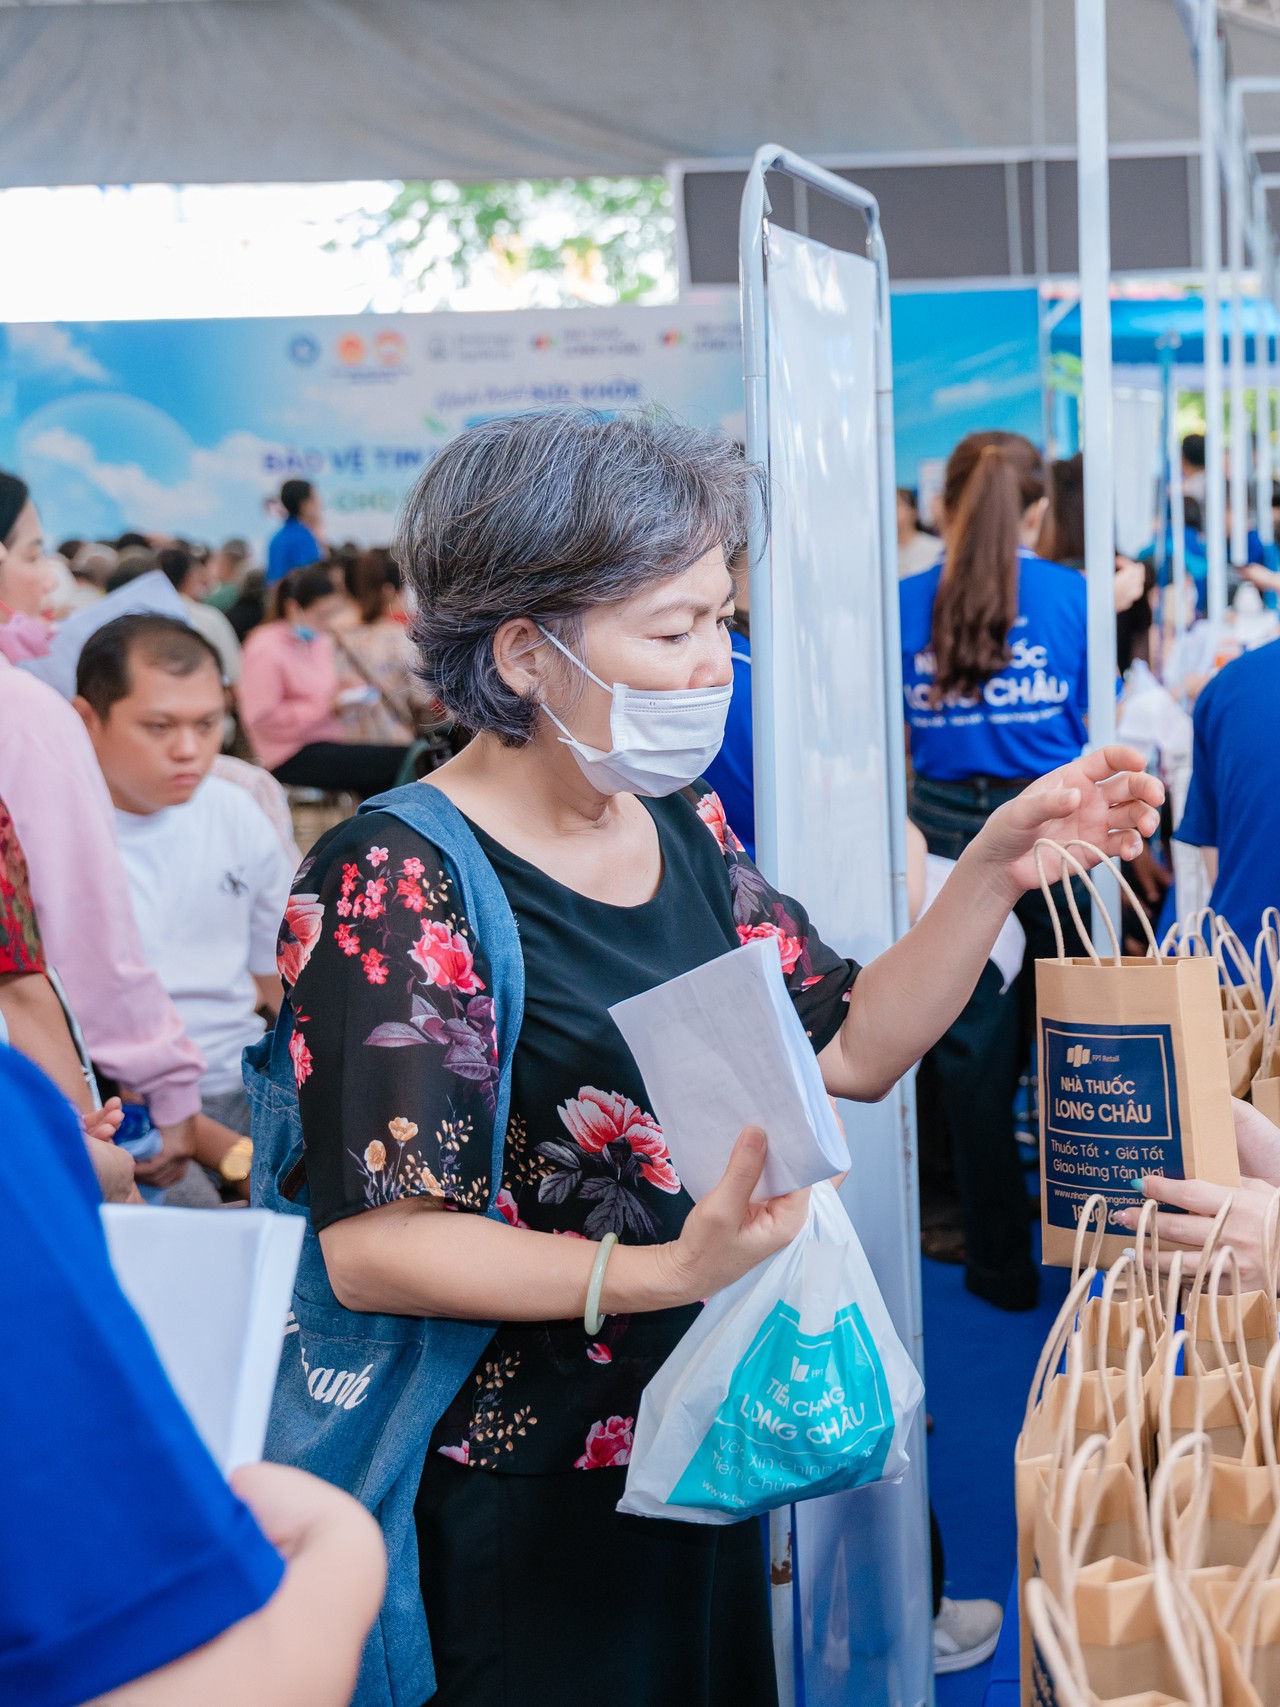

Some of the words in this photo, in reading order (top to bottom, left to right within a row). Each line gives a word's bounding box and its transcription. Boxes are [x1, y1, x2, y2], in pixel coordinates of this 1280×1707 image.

[984, 669, 1069, 707] CHÂU
[1060, 1074, 1084, 1093] NHÀ
[1085, 1074, 1136, 1095] THUỐC
[1055, 1098, 1095, 1121] LONG
[1098, 1099, 1151, 1124] CHÂU
[1051, 1139, 1079, 1156] Thuốc
[1080, 1143, 1100, 1158] Tốt
[1115, 1146, 1139, 1160] Giá
[1141, 1145, 1165, 1161] Tốt
[1053, 1159, 1076, 1175] Giao
[1077, 1162, 1110, 1182] Hàng
[1111, 1165, 1138, 1182] Tận
[811, 1369, 824, 1378] FPT
[793, 1386, 845, 1417] CHNG
[740, 1393, 798, 1441] LONG
[807, 1402, 865, 1445] CHÂU
[749, 1454, 774, 1469] Xin
